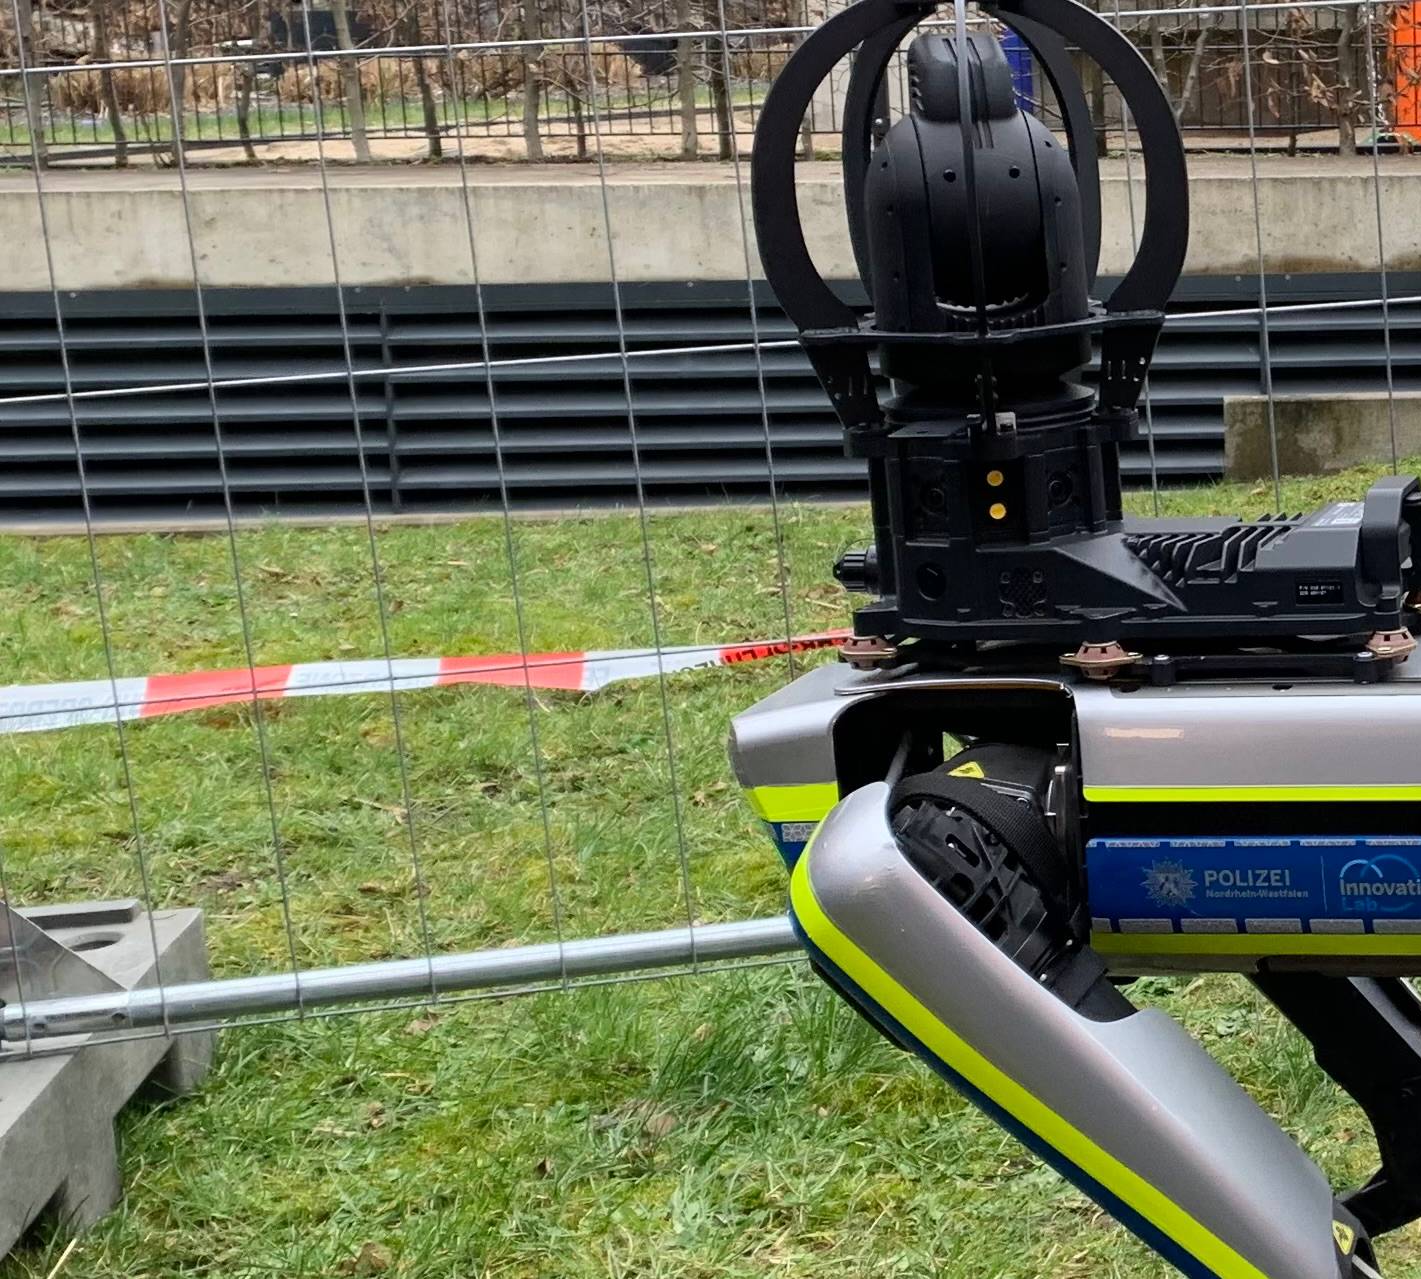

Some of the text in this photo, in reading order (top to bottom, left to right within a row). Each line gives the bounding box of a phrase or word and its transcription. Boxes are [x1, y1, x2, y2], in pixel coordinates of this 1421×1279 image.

[1204, 869, 1290, 887] POLIZEI
[1205, 888, 1308, 899] Nordrhein-Westfalen
[1342, 897, 1378, 912] Lab
